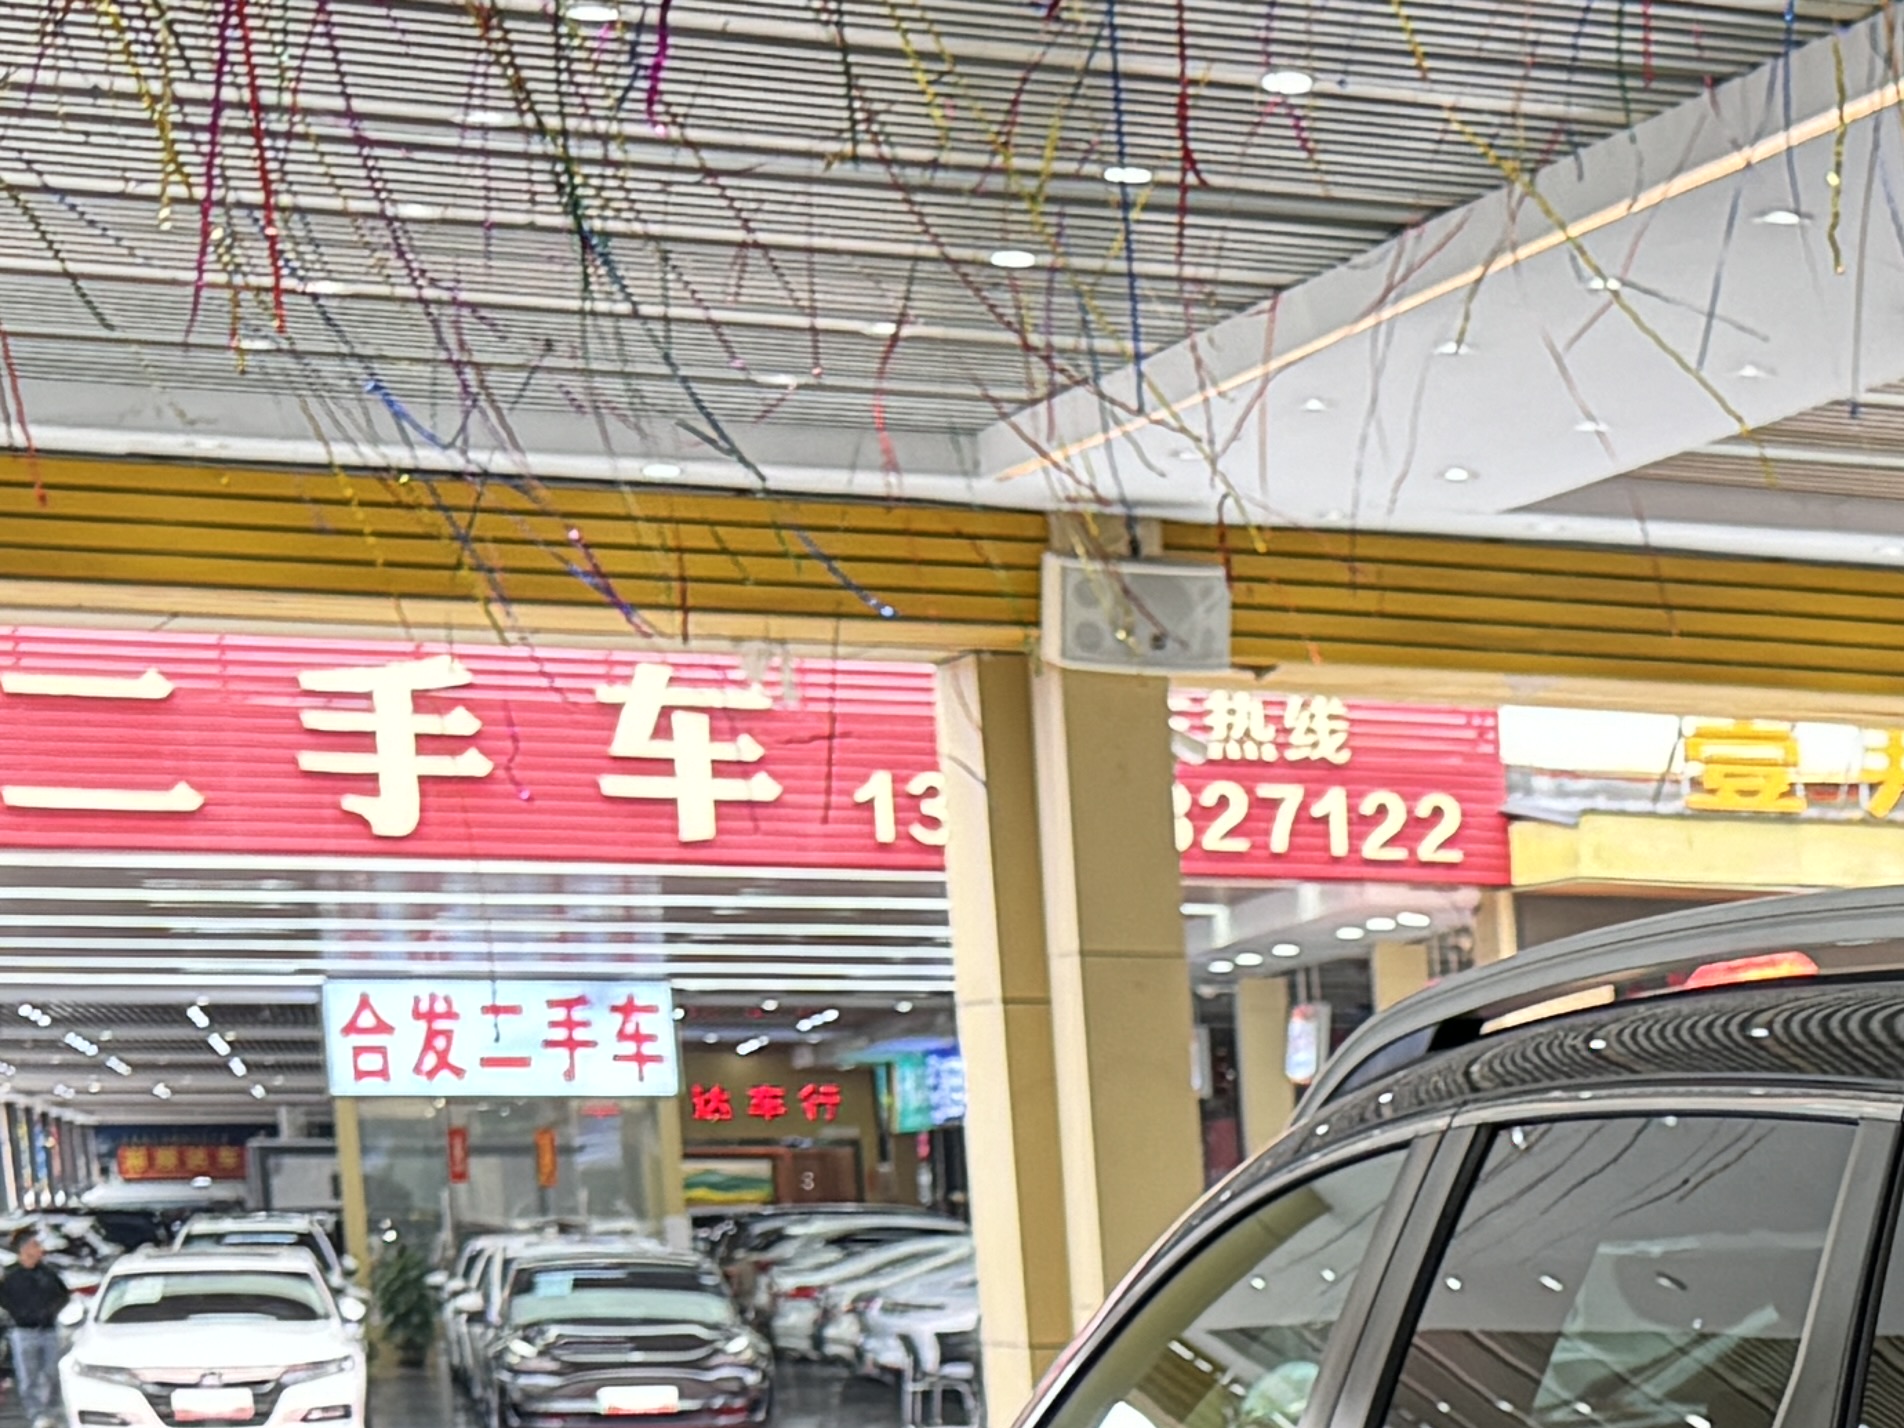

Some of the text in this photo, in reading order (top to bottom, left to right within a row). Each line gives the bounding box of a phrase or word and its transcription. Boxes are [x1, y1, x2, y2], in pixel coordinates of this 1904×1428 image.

[0, 655, 783, 843] 二手车
[340, 991, 665, 1083] 合发二手车
